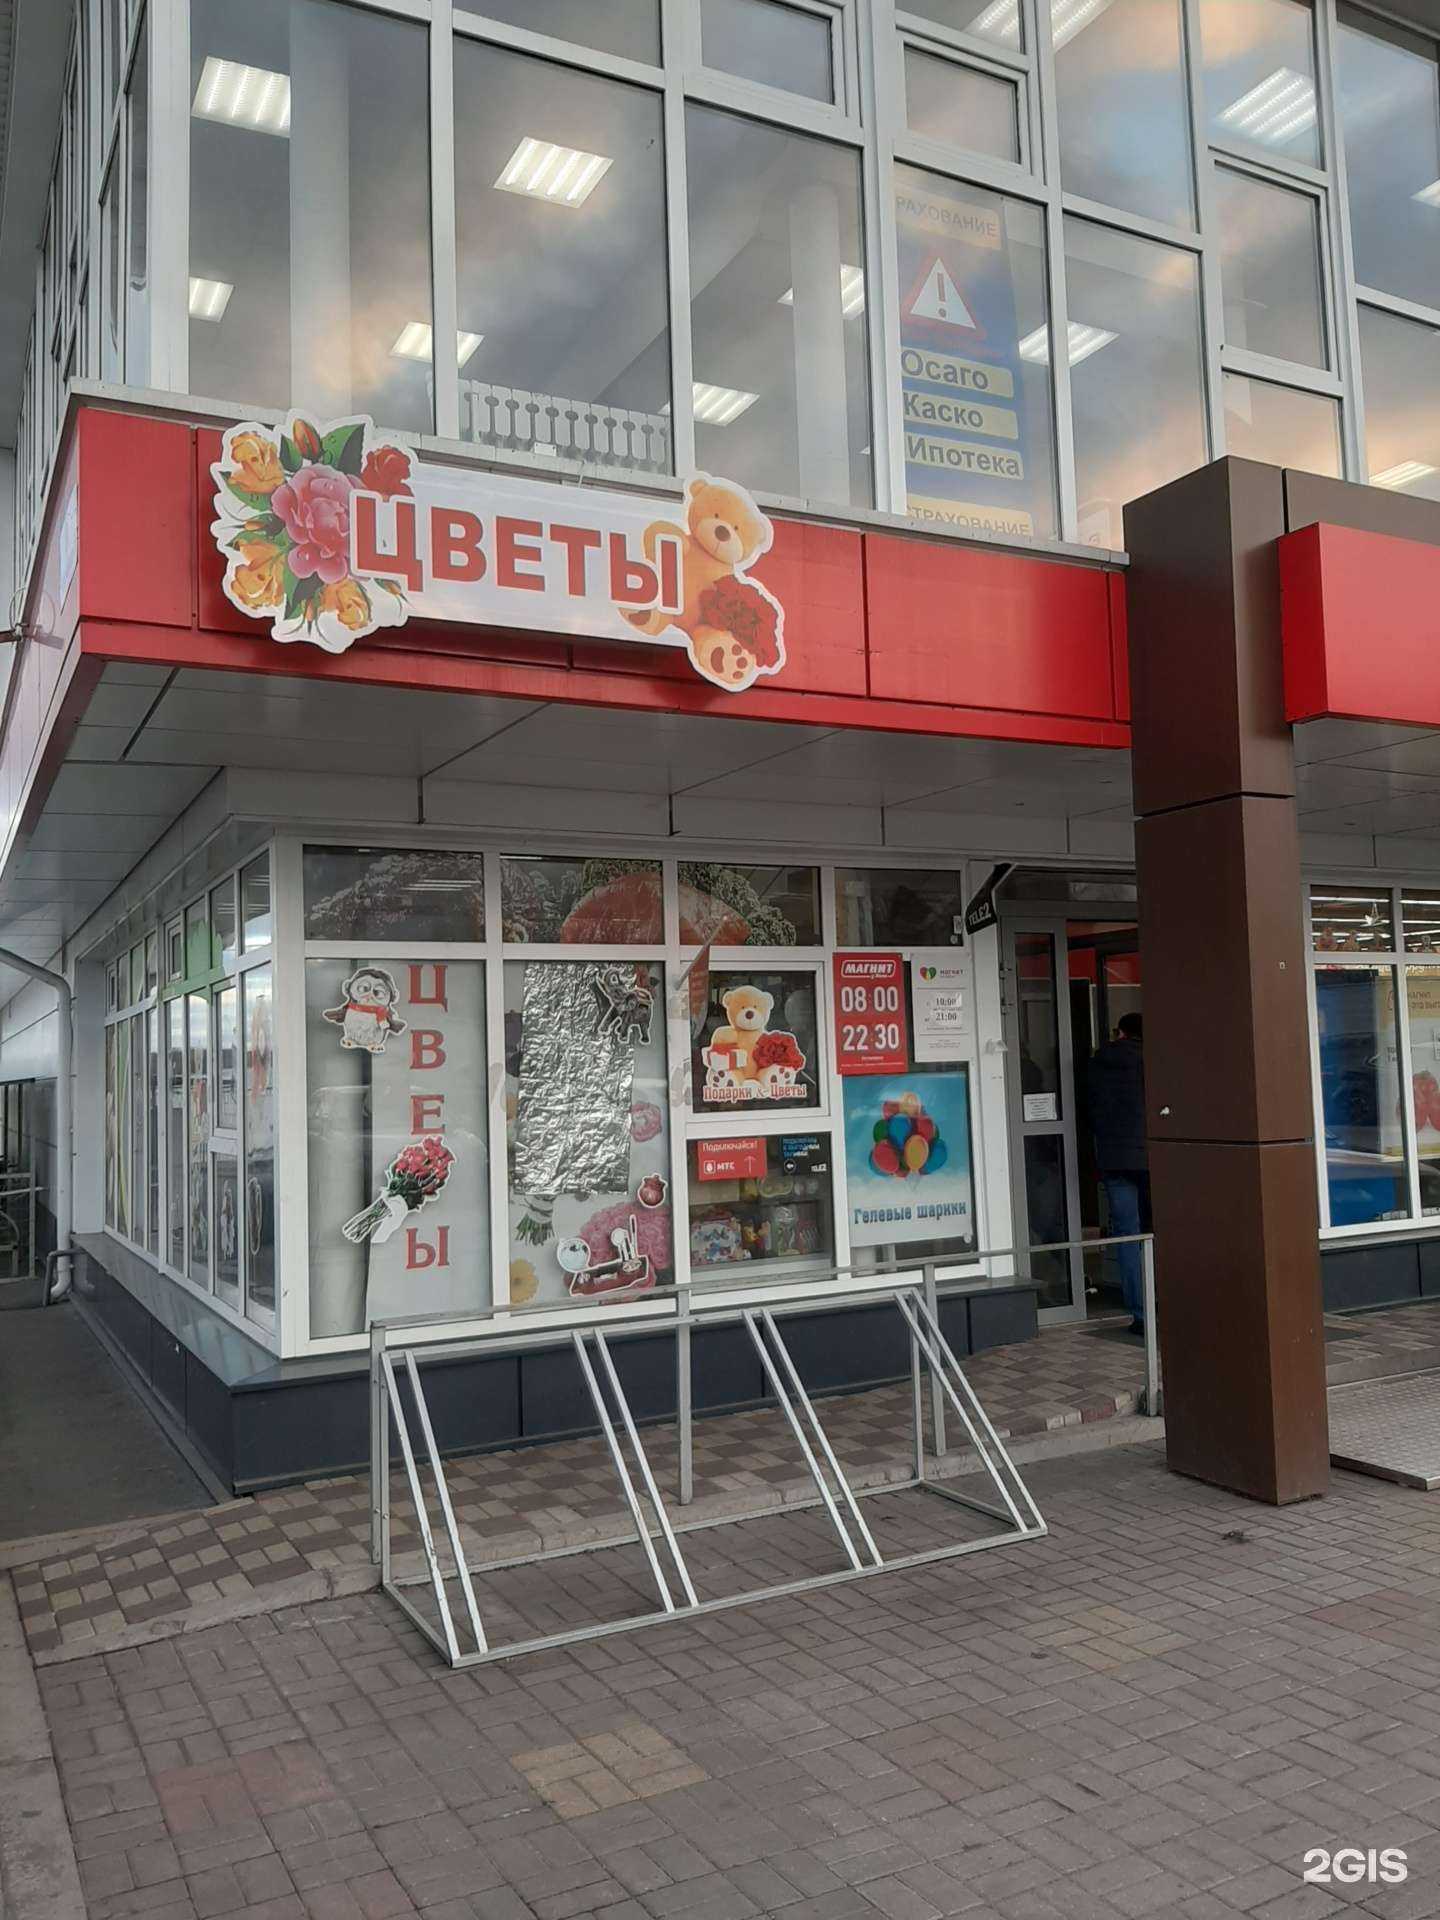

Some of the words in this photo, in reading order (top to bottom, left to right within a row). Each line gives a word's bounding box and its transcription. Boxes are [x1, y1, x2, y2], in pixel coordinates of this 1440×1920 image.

[900, 349, 989, 391] Осаго
[902, 391, 984, 429] Каско
[907, 434, 1021, 477] Ипотека
[907, 503, 1030, 537] ТРАХОВАНИЕ
[355, 496, 681, 609] ЦВЕТЫ
[968, 902, 992, 926] TELE2
[844, 963, 894, 974] МАГНИТ
[704, 1087, 752, 1103] Подарки
[770, 1084, 807, 1099] Цветы
[406, 964, 450, 1270] ЦВЕЫ
[854, 1206, 912, 1224] Гелевые
[916, 1201, 967, 1220] шарики
